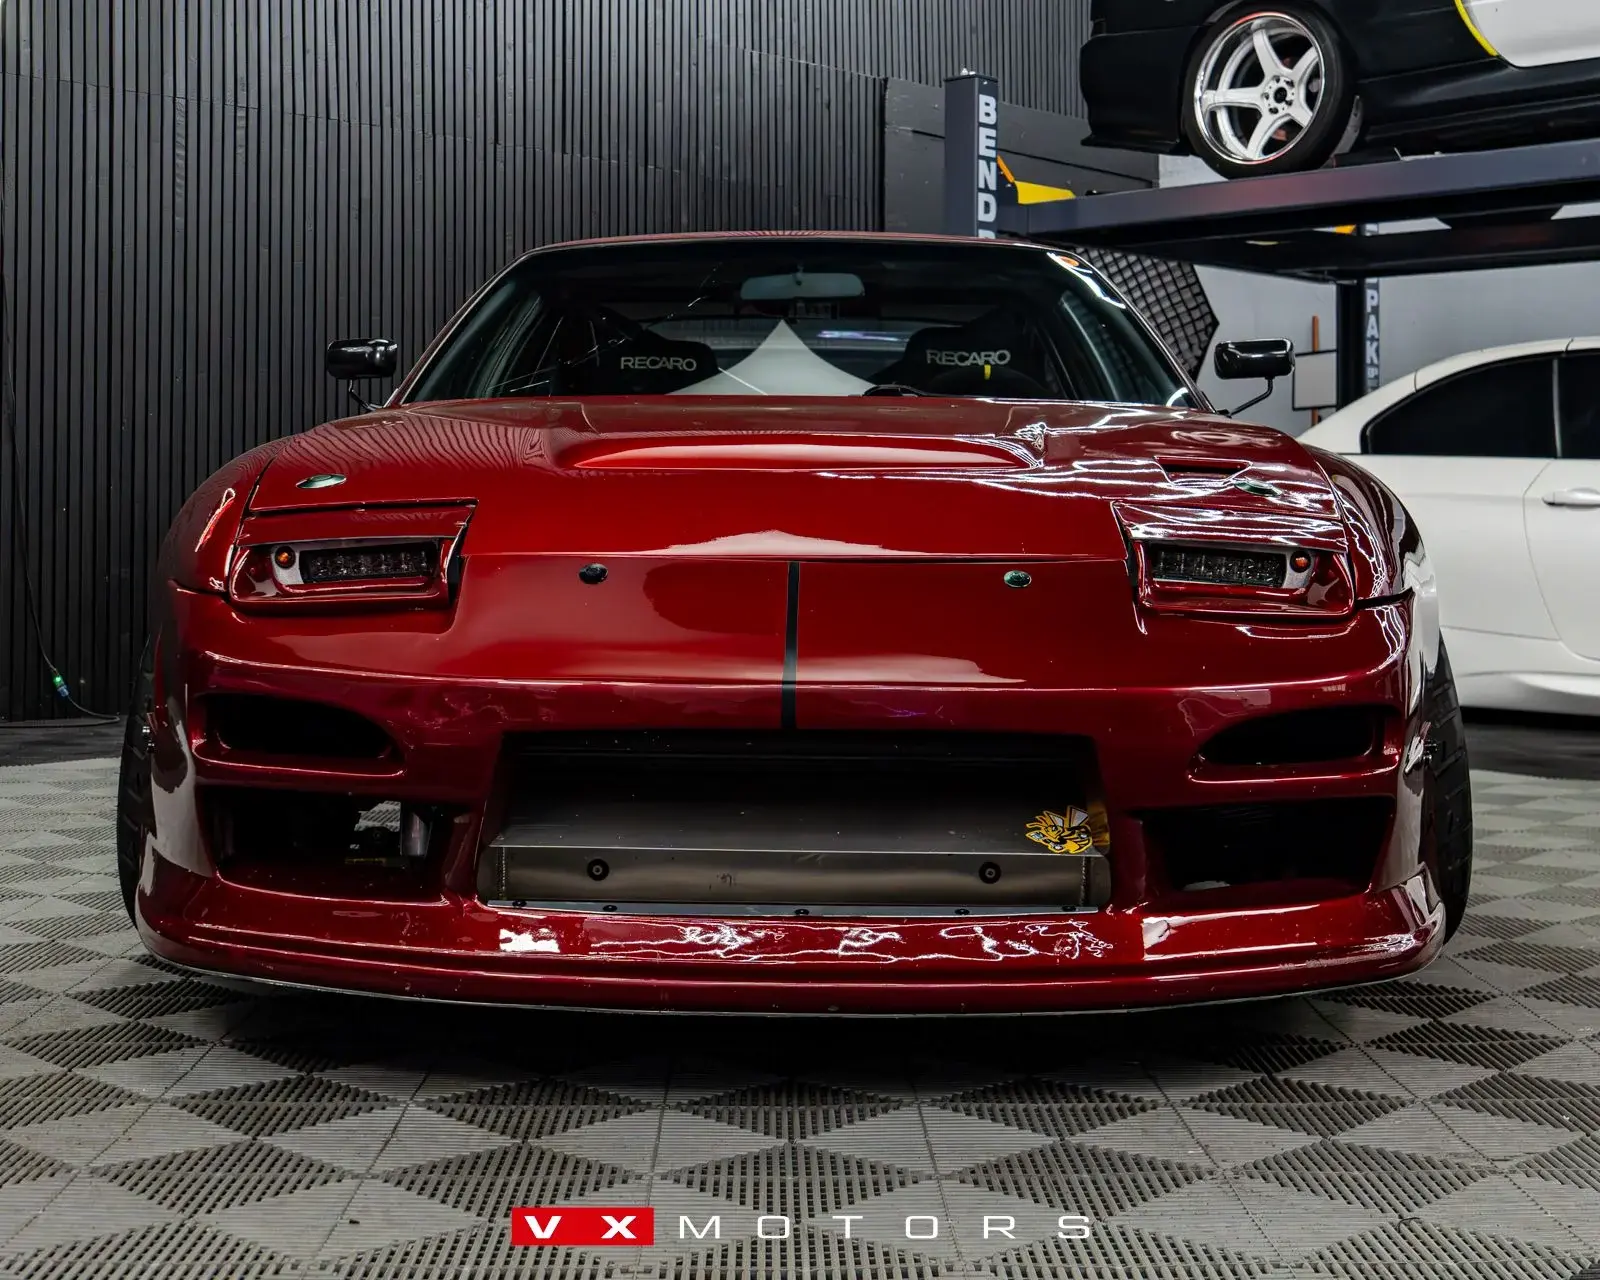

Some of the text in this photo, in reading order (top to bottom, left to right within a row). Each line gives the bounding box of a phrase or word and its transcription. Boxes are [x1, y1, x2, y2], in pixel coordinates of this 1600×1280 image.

[1365, 278, 1379, 365] PAK
[620, 356, 698, 372] RECARO
[926, 349, 1011, 367] RECARO
